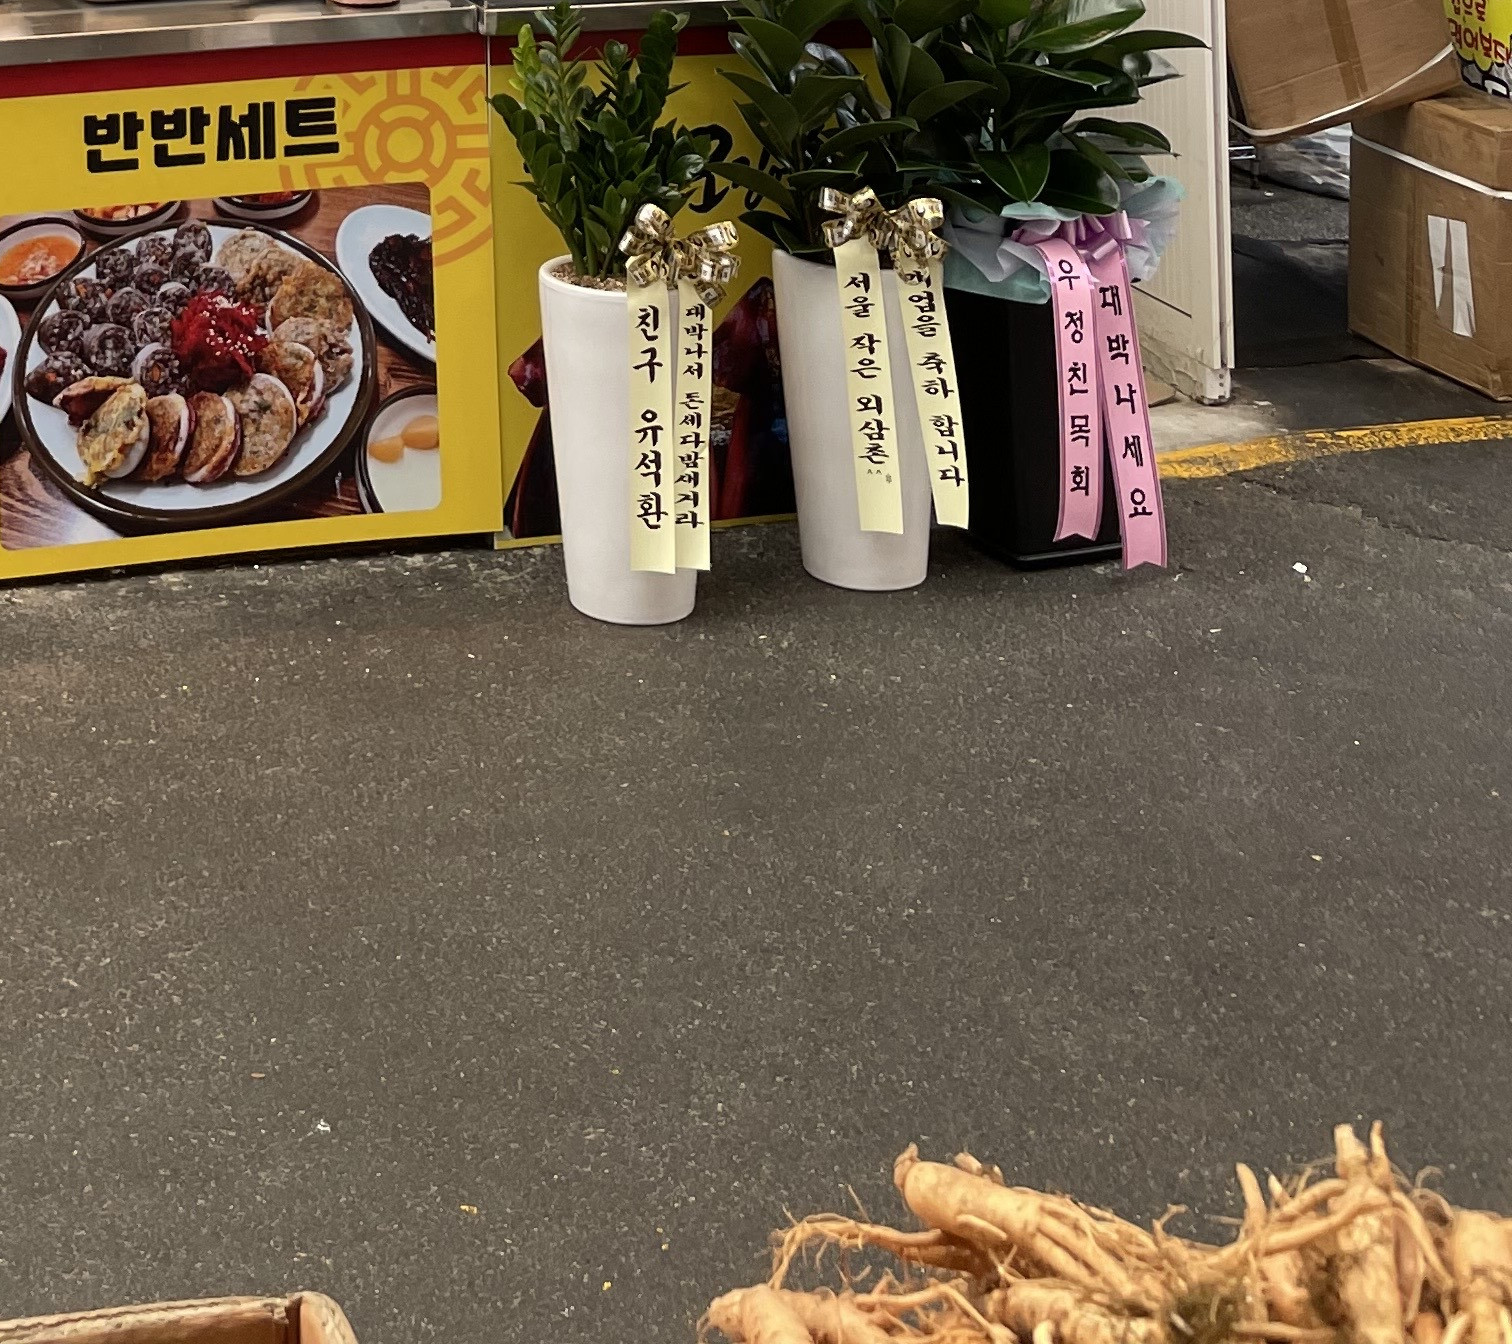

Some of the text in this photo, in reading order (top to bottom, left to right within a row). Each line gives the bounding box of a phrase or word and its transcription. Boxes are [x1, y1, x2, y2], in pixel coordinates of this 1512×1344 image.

[83, 95, 340, 175] 반반세트
[843, 272, 876, 318] 서울
[682, 303, 708, 380] 대박나서
[850, 332, 882, 379] 작은
[633, 304, 669, 530] 친구 유석환
[856, 394, 890, 464] 외삼촌
